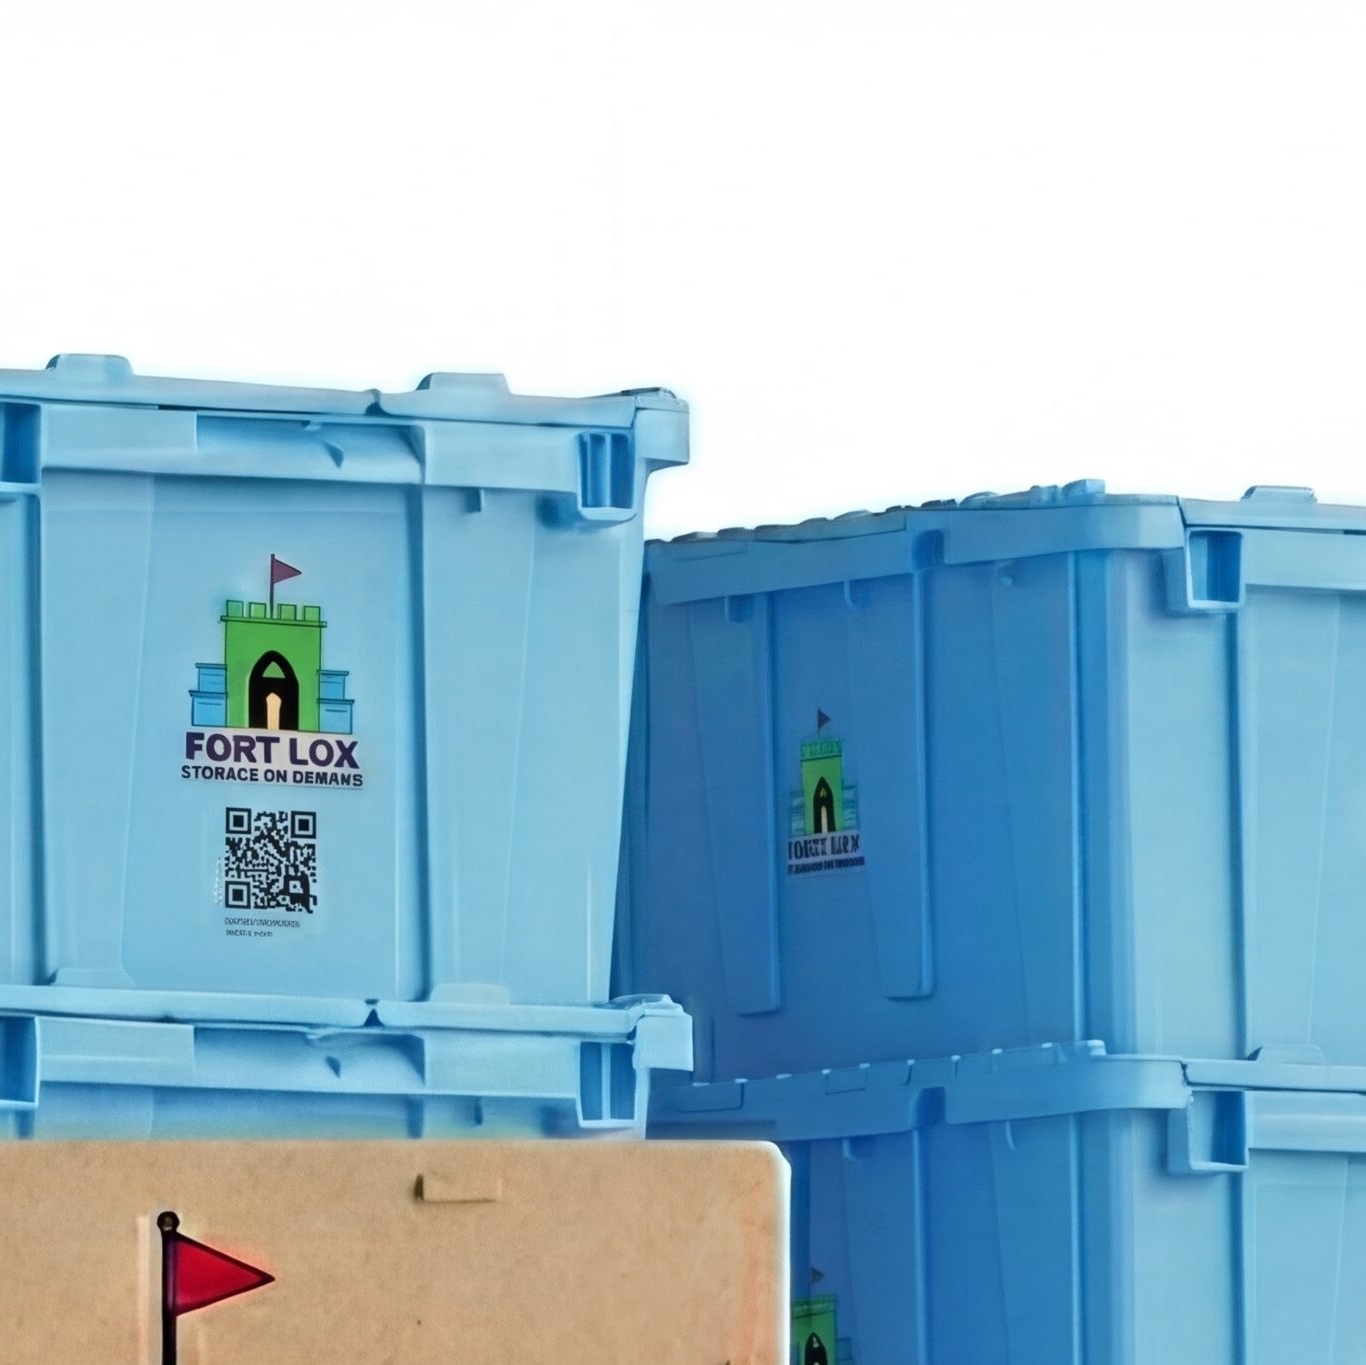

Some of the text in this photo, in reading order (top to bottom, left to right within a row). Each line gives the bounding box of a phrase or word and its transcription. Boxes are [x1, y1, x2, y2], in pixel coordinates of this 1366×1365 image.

[186, 731, 360, 769] FORT LOX
[263, 769, 287, 783] ON
